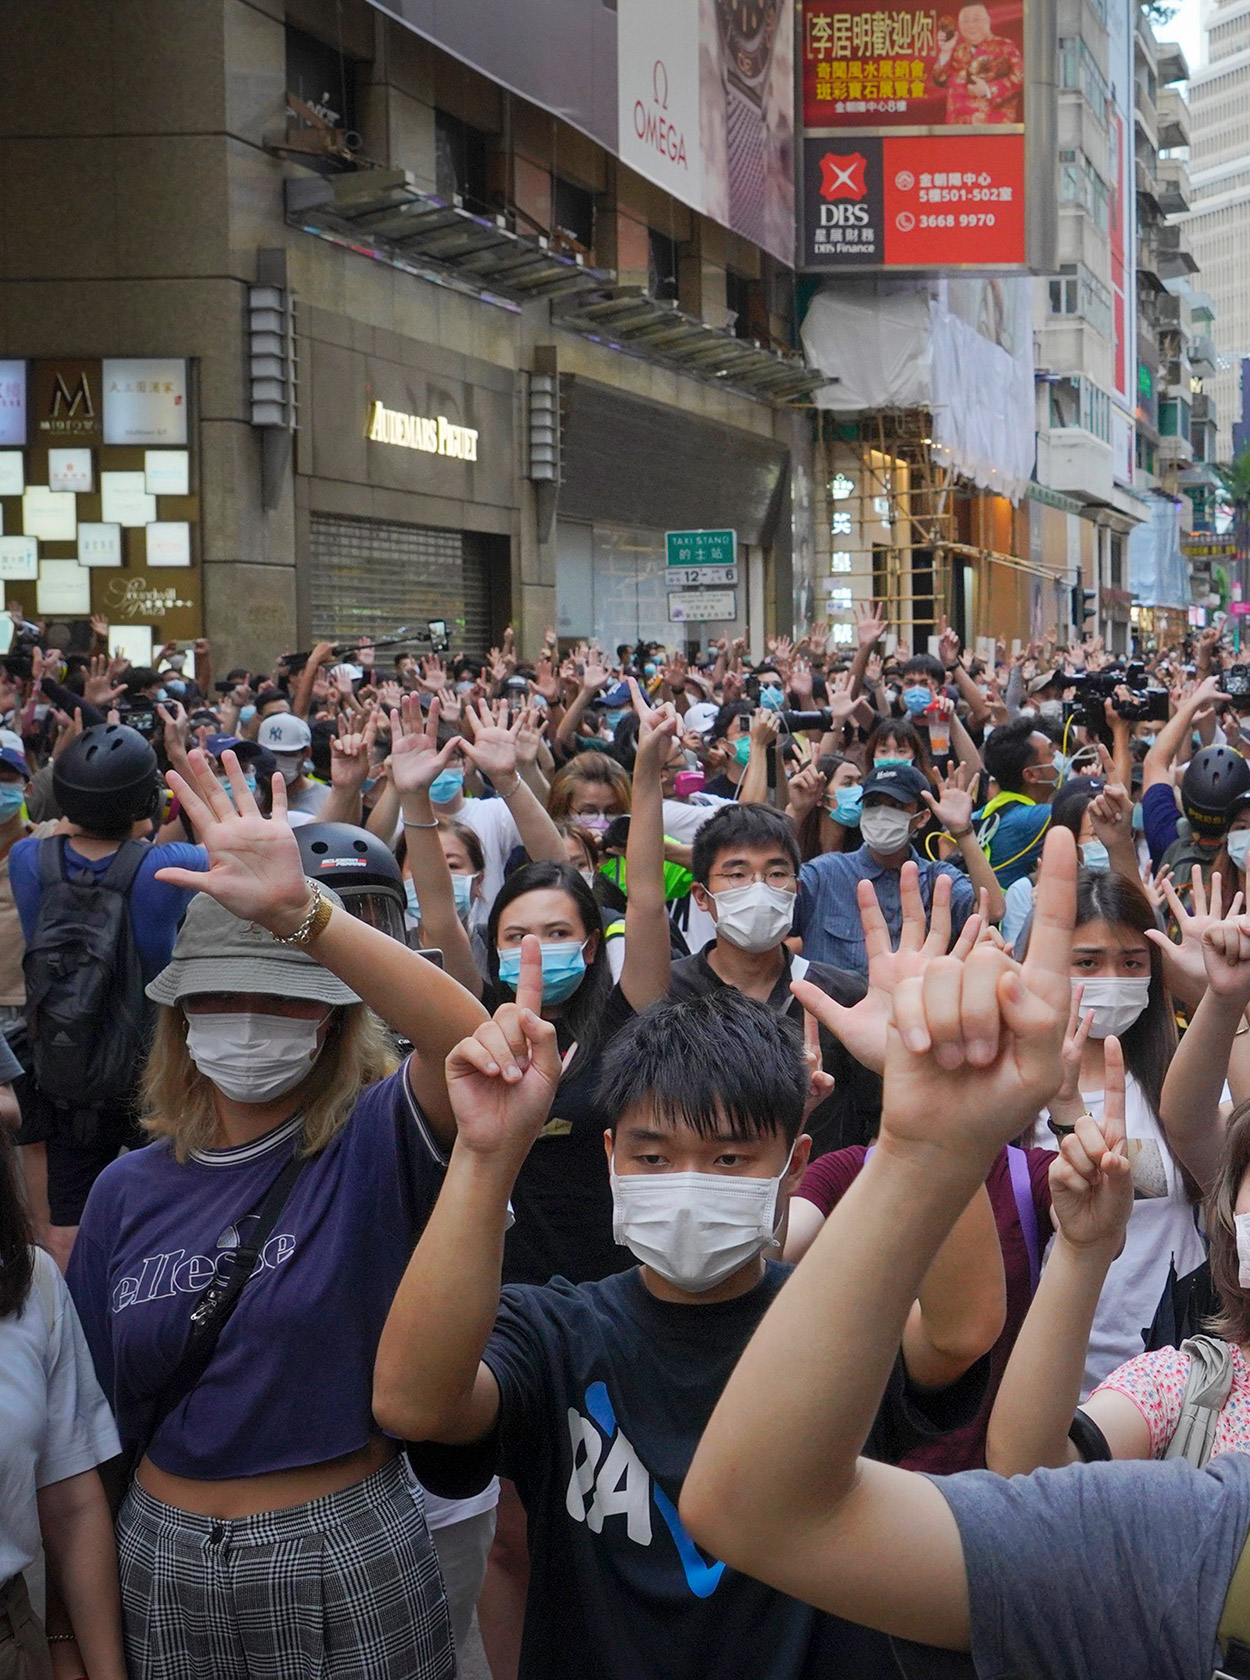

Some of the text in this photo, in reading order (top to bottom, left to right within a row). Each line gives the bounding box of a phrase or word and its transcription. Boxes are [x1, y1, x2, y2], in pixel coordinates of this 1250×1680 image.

[633, 99, 688, 170] OMEGA
[919, 172, 992, 188] 金朝陽中心
[919, 187, 1013, 203] 5樓501-502室
[820, 203, 869, 226] DBS
[919, 213, 995, 228] 3668 9970
[815, 228, 875, 243] 星展財務
[814, 243, 876, 254] DBS Finance
[672, 534, 730, 546] TAXI STAND
[678, 547, 724, 561] 的士站
[685, 570, 700, 583] 12
[725, 568, 735, 581] 6
